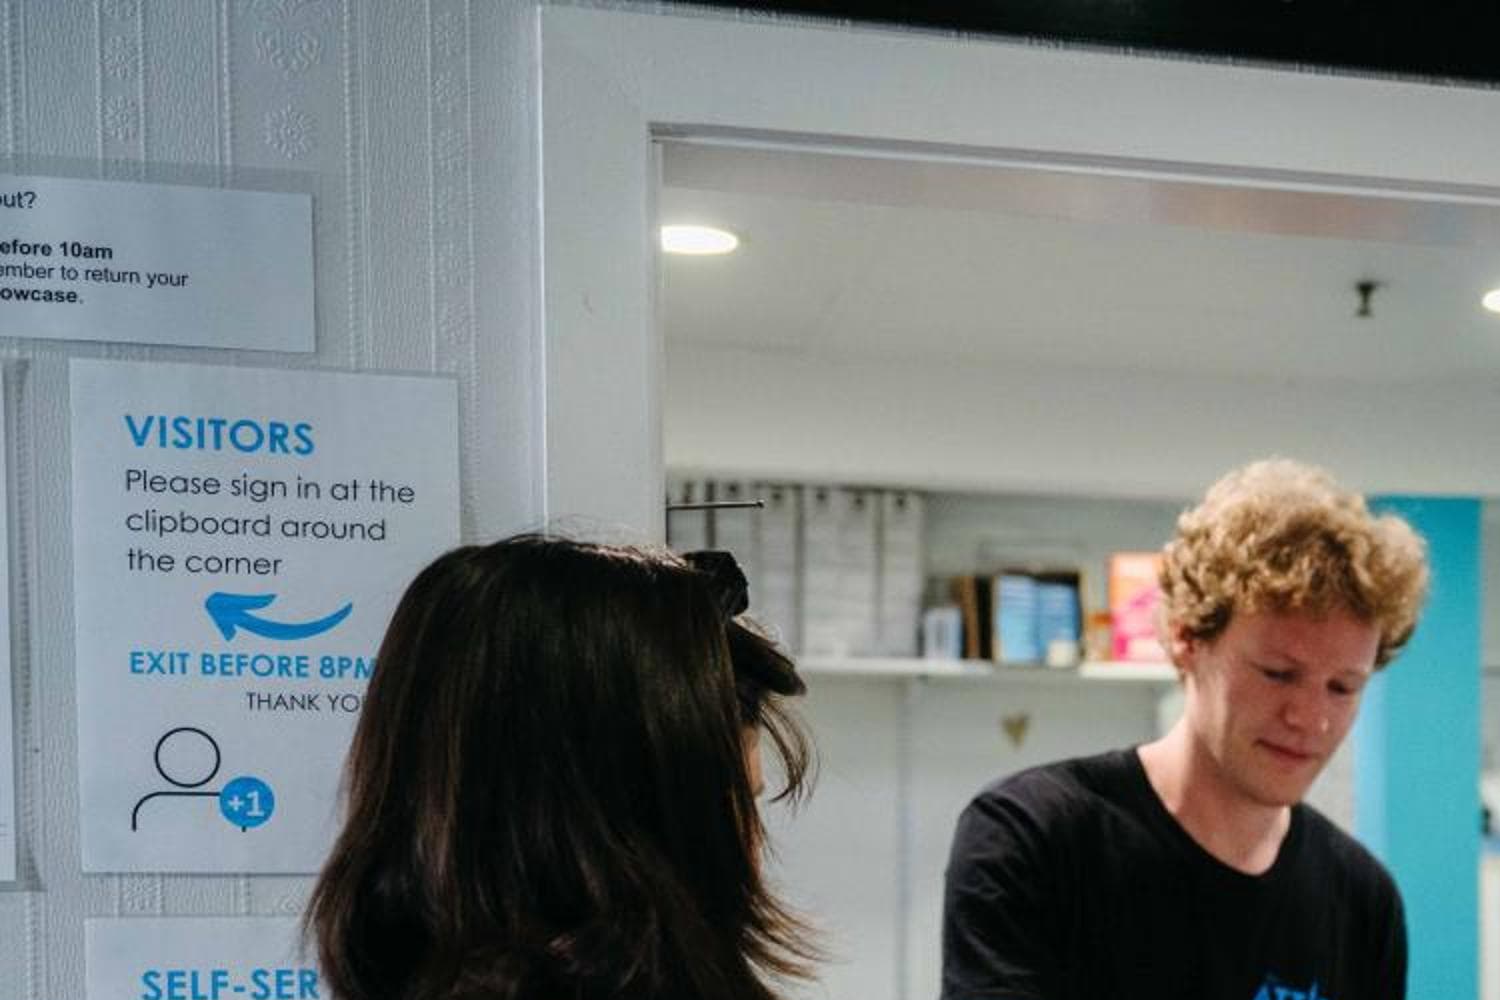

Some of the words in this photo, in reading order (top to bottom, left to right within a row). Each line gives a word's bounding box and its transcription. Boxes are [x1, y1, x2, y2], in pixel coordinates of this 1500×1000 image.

[0, 191, 36, 208] ut?
[59, 241, 113, 260] 10am
[61, 265, 79, 281] to
[85, 267, 140, 284] return
[146, 273, 189, 288] your
[125, 414, 315, 456] VISITORS
[125, 468, 221, 495] Please
[231, 473, 287, 502] sign
[297, 475, 320, 500] in
[330, 478, 357, 501] at
[369, 477, 415, 503] the
[125, 508, 271, 538] clipboard
[281, 518, 386, 541] around
[127, 549, 175, 572] the
[185, 553, 283, 576] corner
[129, 651, 191, 675] EXIT
[201, 654, 310, 678] BEFORE
[247, 692, 320, 712] THANK
[326, 694, 367, 713] YO
[227, 791, 265, 817] +1
